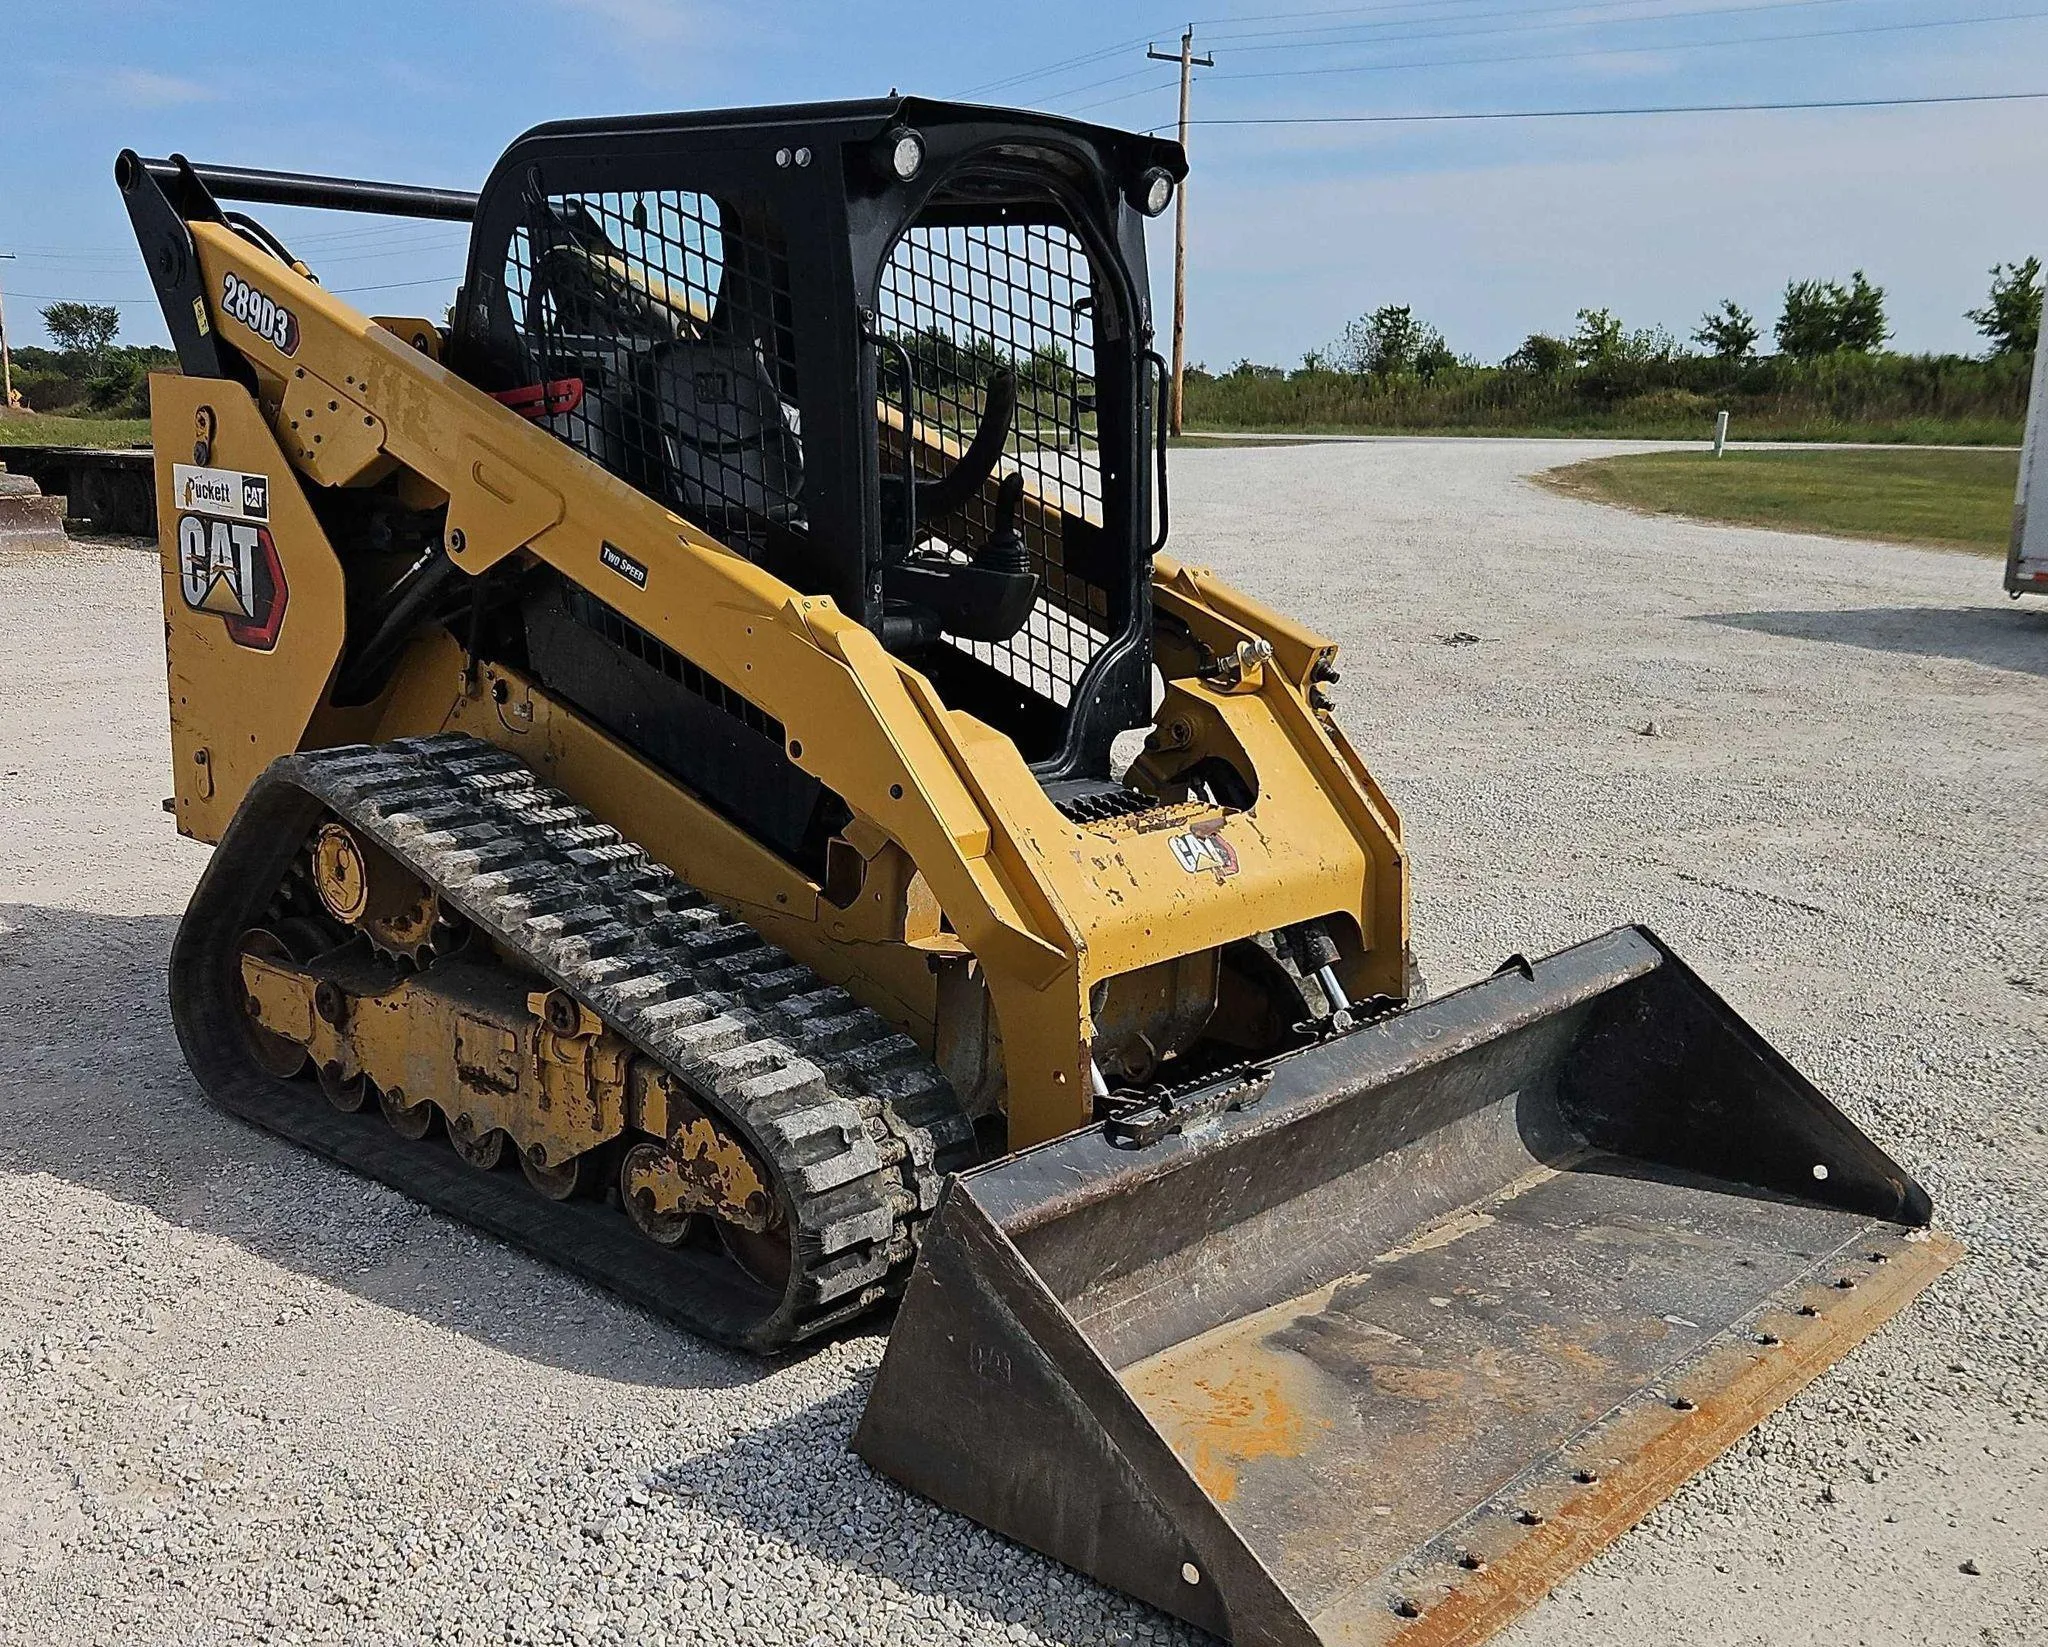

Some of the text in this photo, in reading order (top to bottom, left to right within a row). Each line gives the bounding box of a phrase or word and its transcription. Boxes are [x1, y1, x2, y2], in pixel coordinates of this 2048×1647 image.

[222, 273, 289, 348] 289D3
[244, 485, 265, 508] CAT
[180, 516, 259, 618] CAT
[603, 547, 644, 581] TWO SPEED
